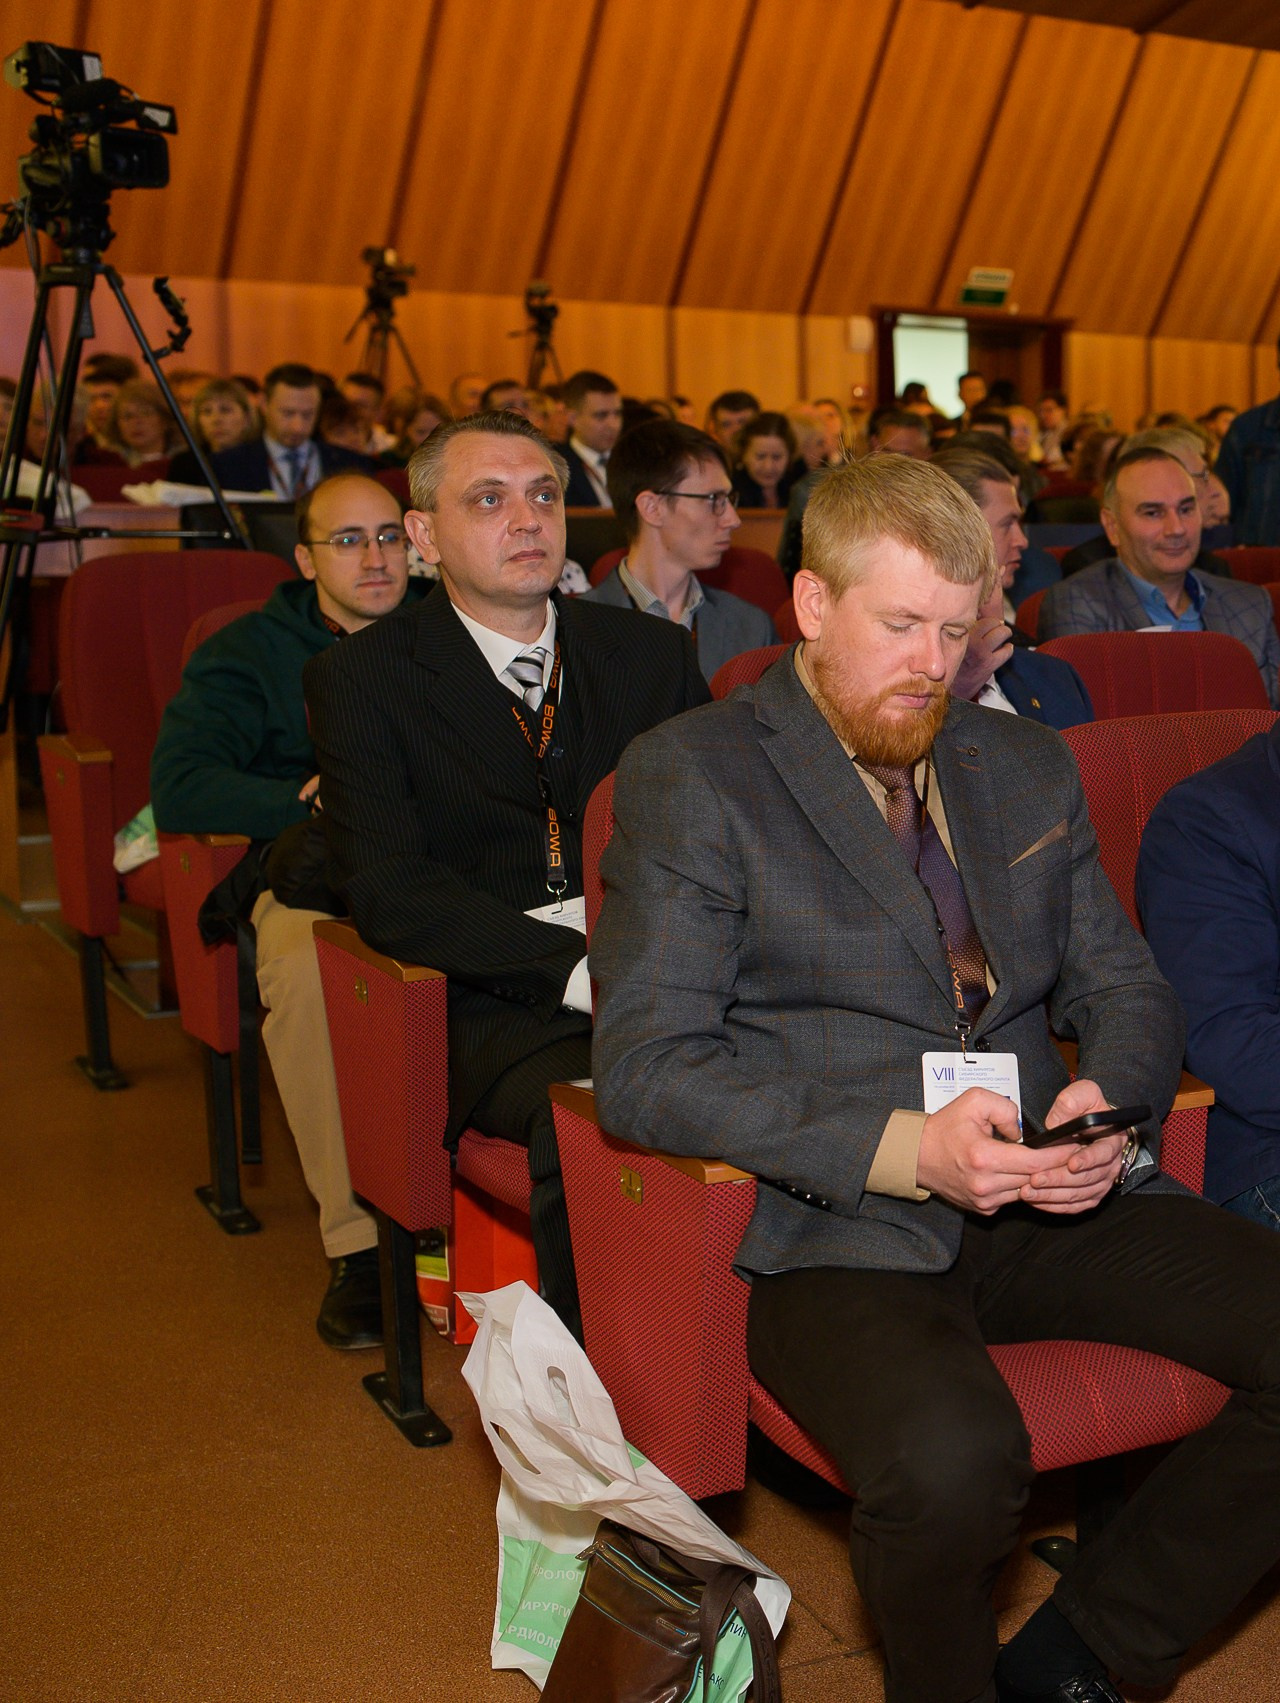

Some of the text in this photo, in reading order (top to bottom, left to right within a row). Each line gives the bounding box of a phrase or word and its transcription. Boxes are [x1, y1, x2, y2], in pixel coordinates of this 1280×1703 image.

[537, 704, 555, 759] BOWA
[548, 807, 561, 867] BOWA
[932, 1067, 955, 1081] VIII
